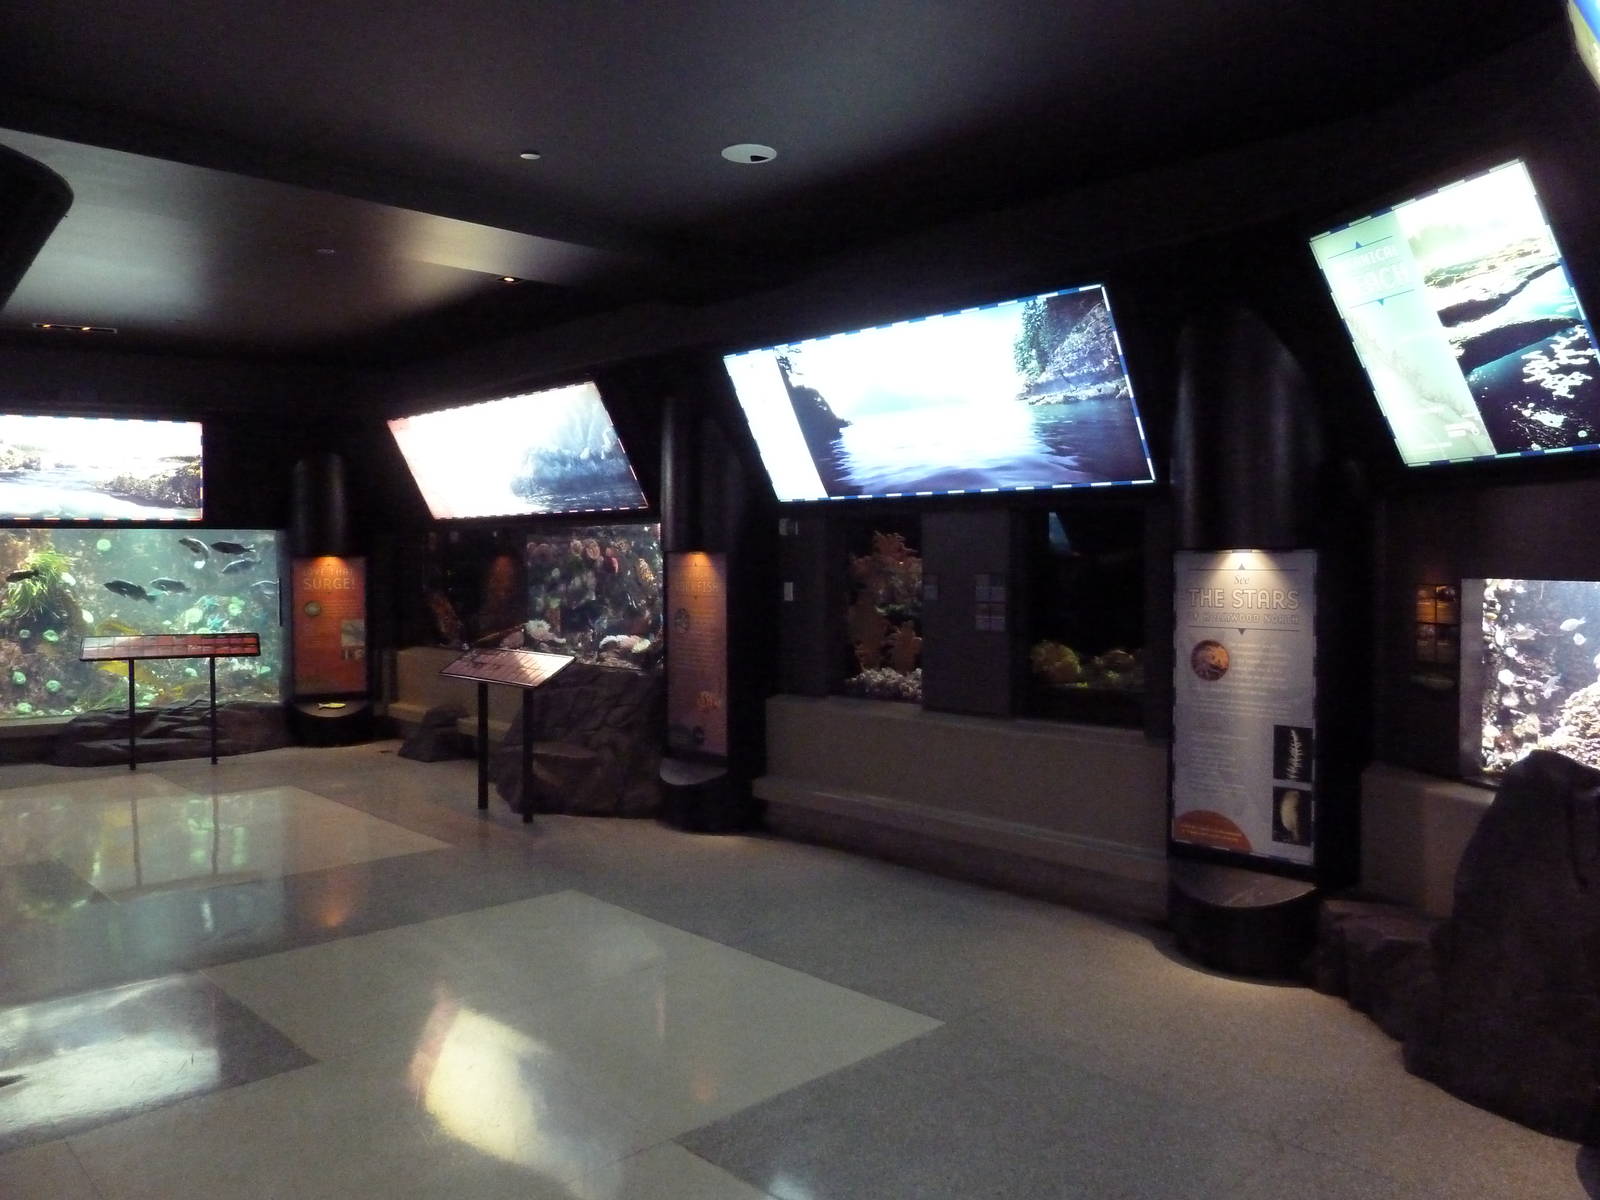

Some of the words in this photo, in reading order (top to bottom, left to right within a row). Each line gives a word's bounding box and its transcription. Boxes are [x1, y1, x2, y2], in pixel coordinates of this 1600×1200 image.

[303, 577, 355, 590] SURGE!
[1188, 588, 1225, 609] THE
[1231, 588, 1300, 611] STARS
